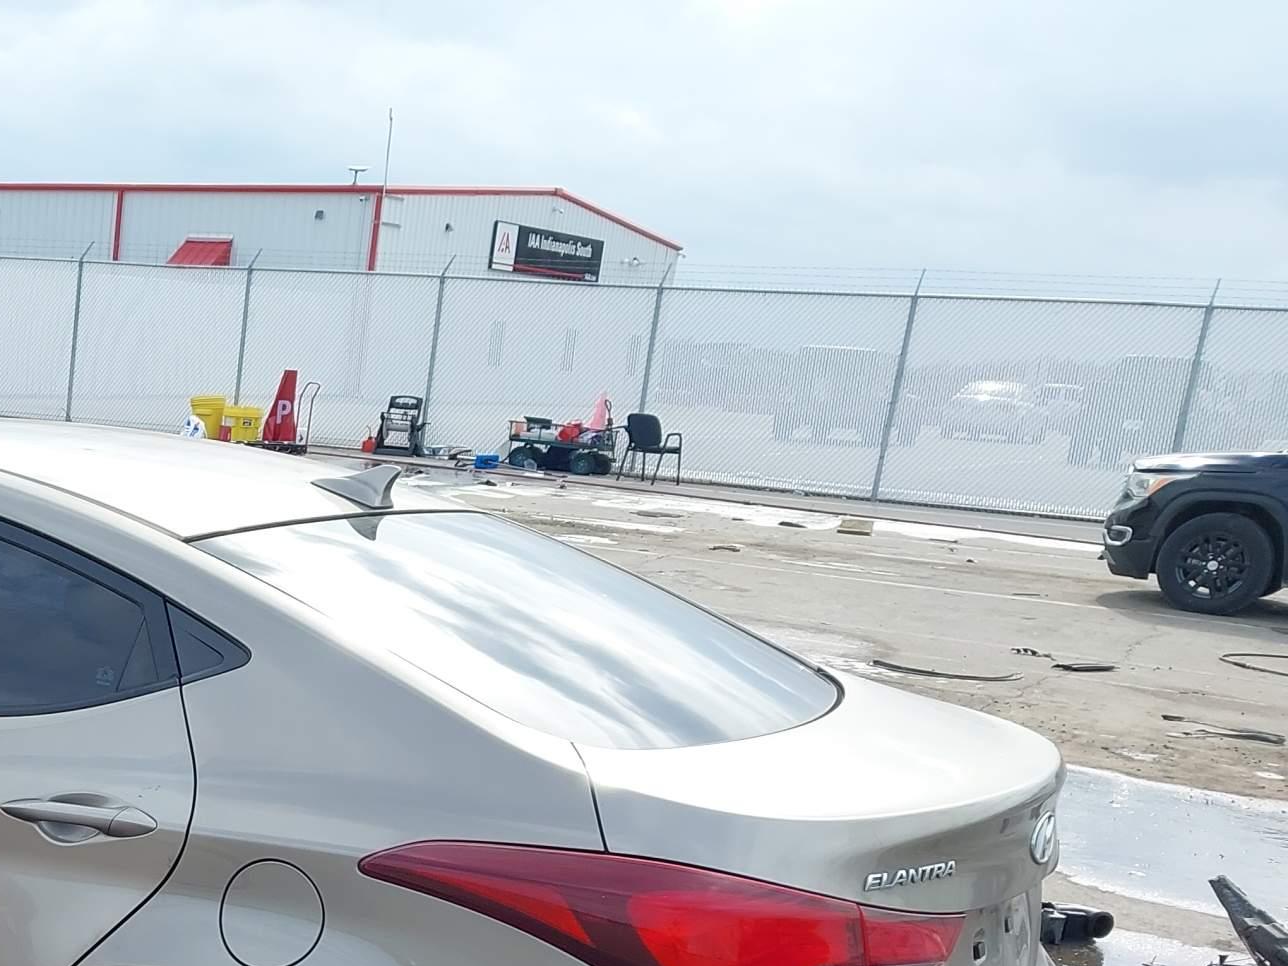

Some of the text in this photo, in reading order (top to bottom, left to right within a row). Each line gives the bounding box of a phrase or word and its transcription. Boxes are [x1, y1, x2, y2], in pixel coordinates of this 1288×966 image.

[541, 235, 576, 256] Indianapolis
[576, 241, 592, 258] South
[276, 400, 292, 424] P
[864, 860, 956, 891] ELANTRA
